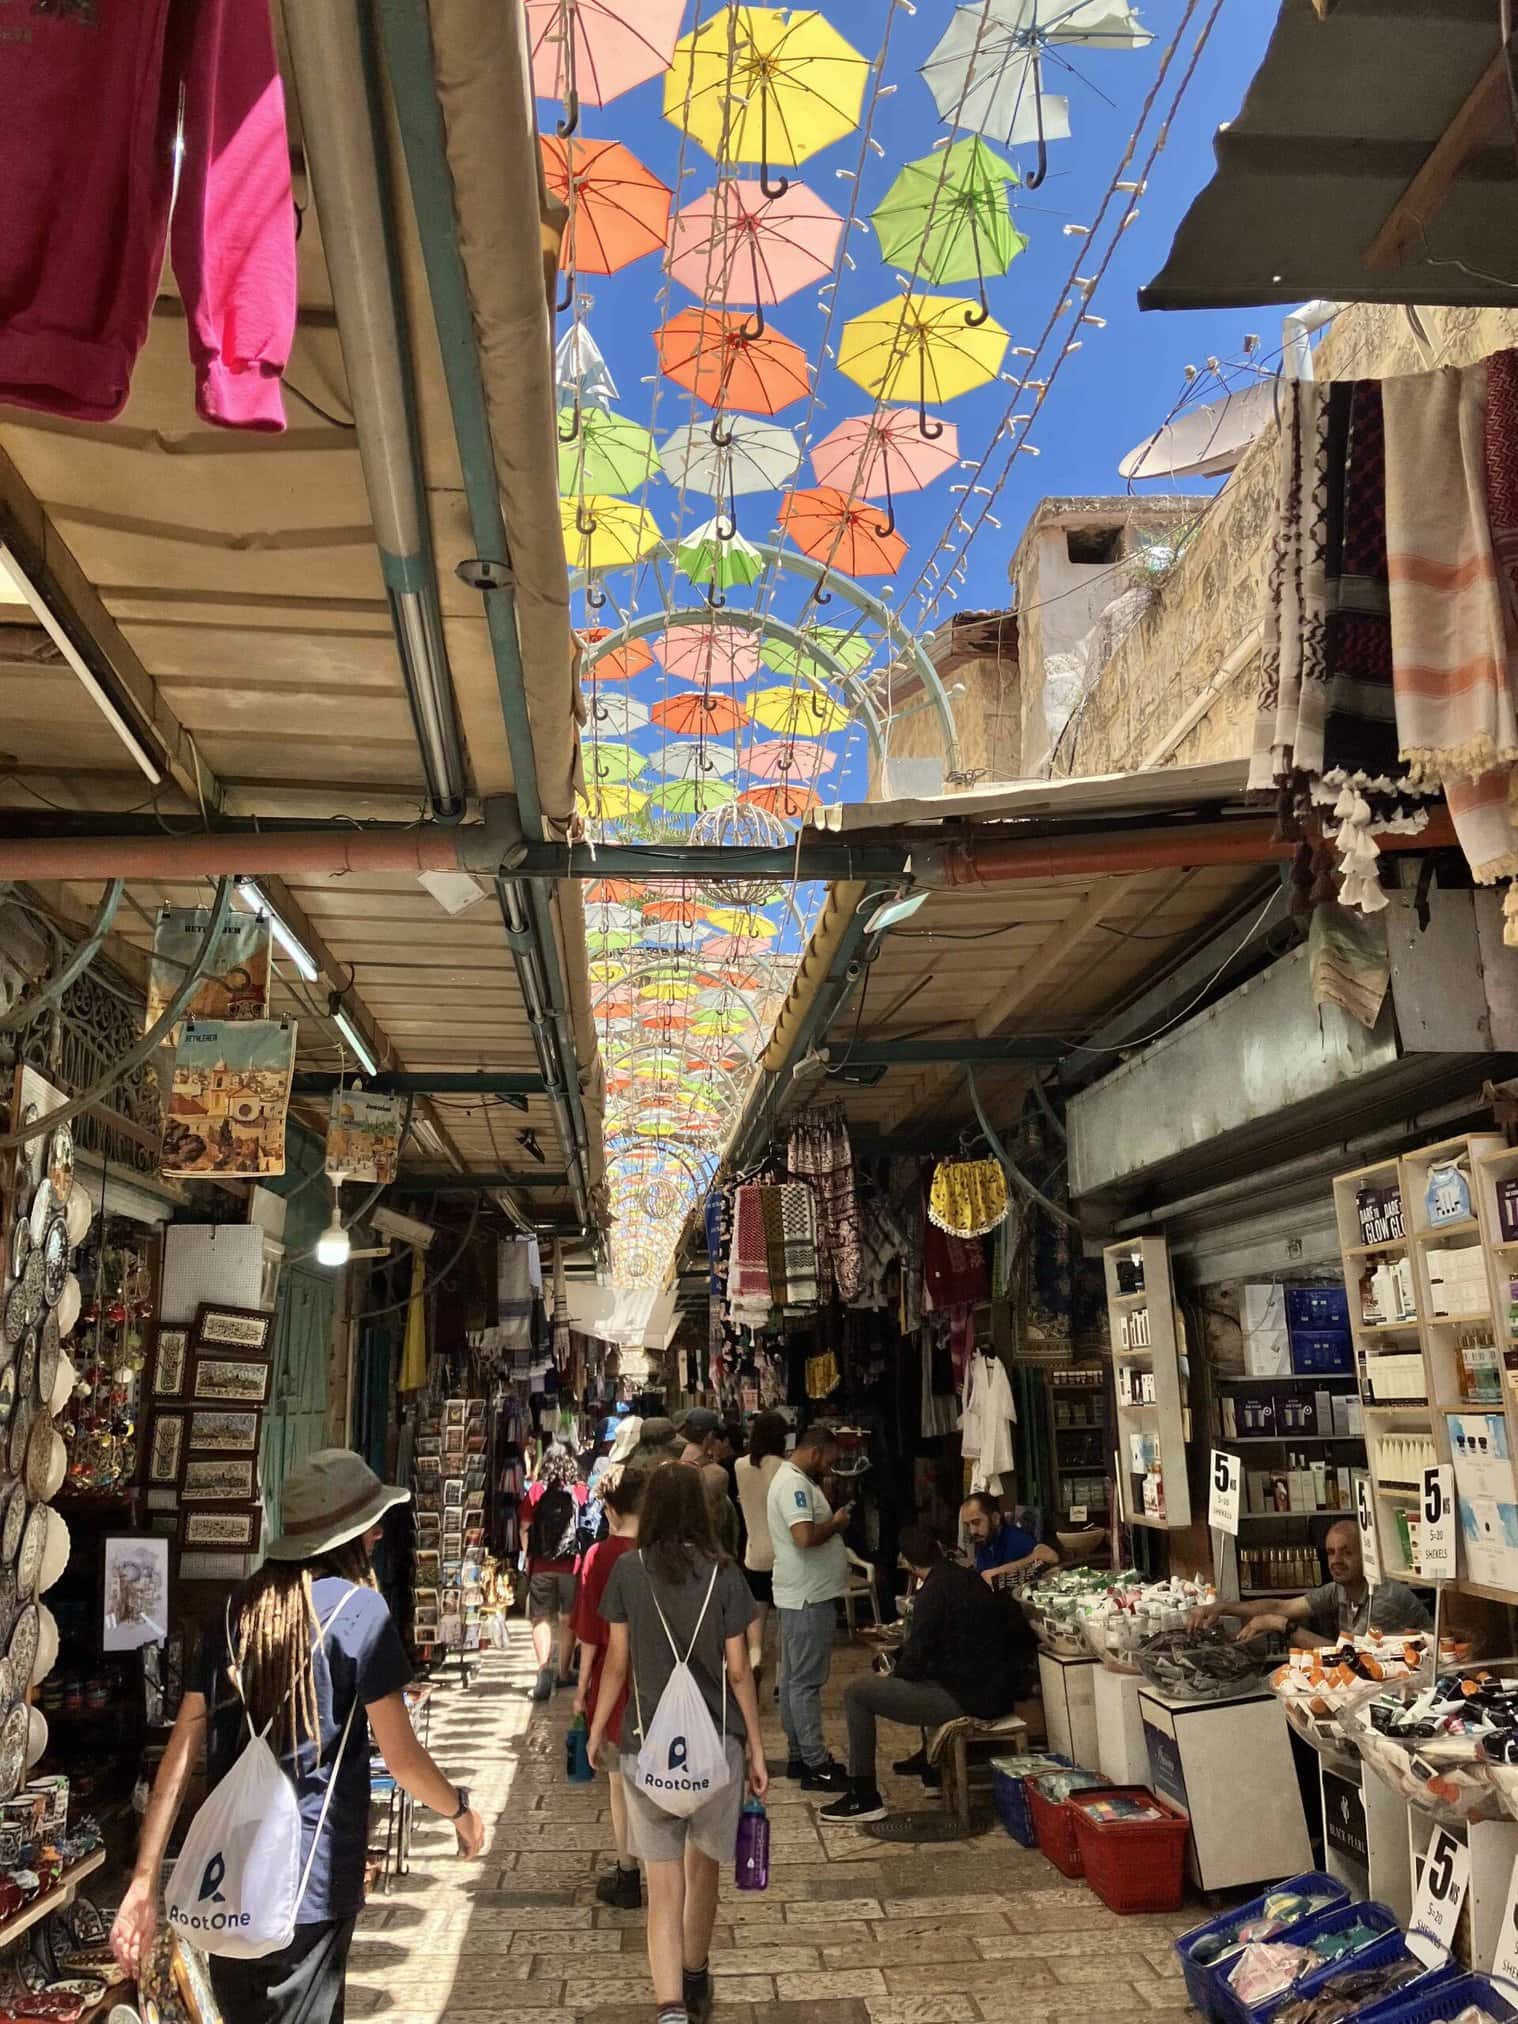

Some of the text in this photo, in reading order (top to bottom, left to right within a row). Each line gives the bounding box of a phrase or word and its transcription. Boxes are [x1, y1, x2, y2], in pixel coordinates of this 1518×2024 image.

[1365, 1217, 1391, 1245] GLOW
[1215, 1453, 1229, 1493] 5
[794, 1490, 807, 1508] 8
[1358, 1481, 1368, 1532] 5
[1424, 1468, 1442, 1524] 5
[645, 1773, 710, 1792] RootOne
[1428, 1830, 1458, 1901] 5
[169, 1904, 251, 1931] RootOne
